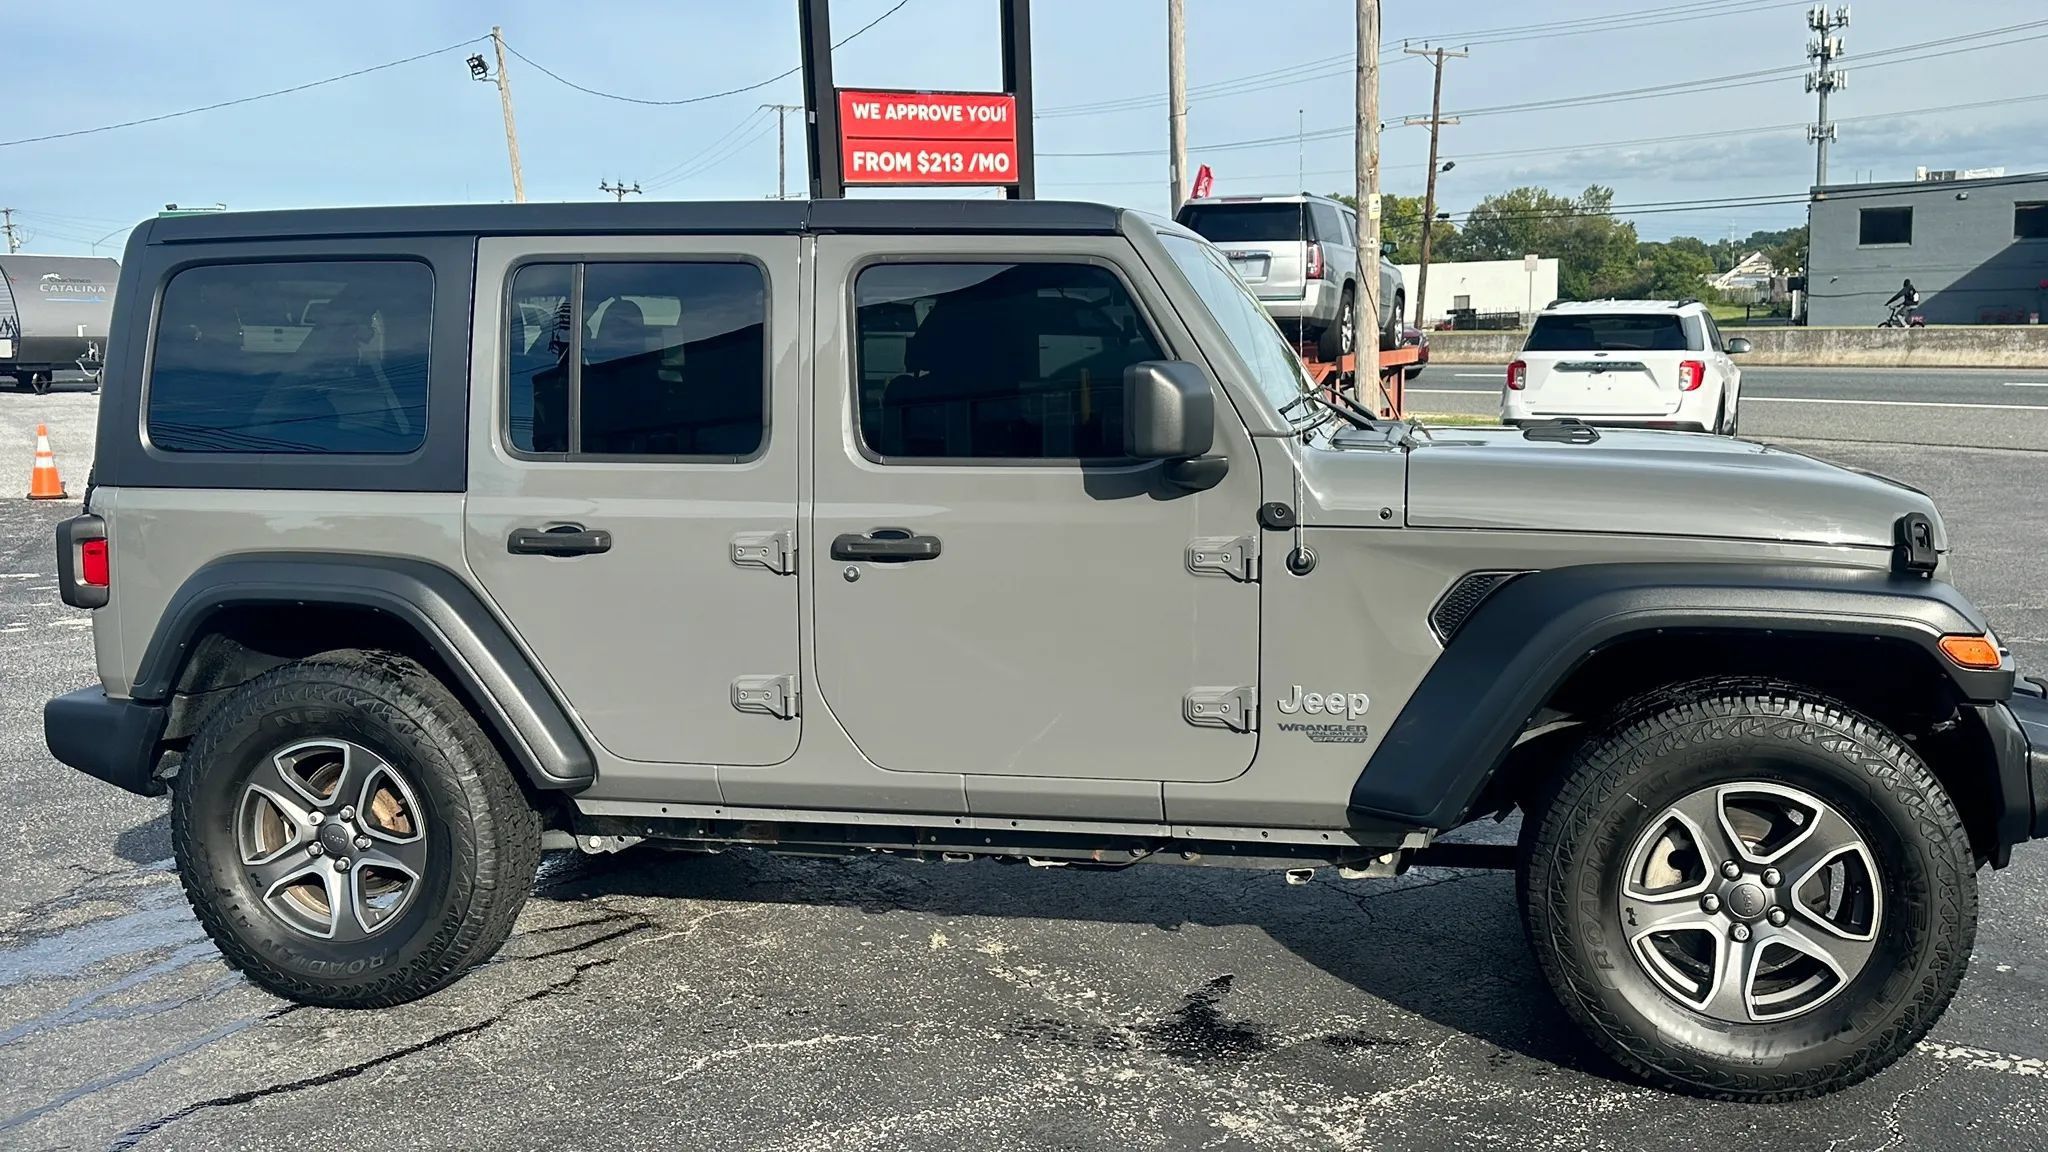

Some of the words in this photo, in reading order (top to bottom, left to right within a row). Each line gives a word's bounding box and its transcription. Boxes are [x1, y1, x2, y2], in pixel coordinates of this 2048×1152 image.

[852, 102, 881, 120] WE
[885, 103, 963, 122] APPROVE
[967, 105, 1007, 122] YOU!
[853, 151, 911, 172] FROM
[917, 150, 964, 175] $213
[968, 152, 1010, 173] /MO
[40, 283, 106, 293] CATALINA
[1277, 685, 1370, 720] Jeep
[1278, 723, 1368, 732] WRANGLER
